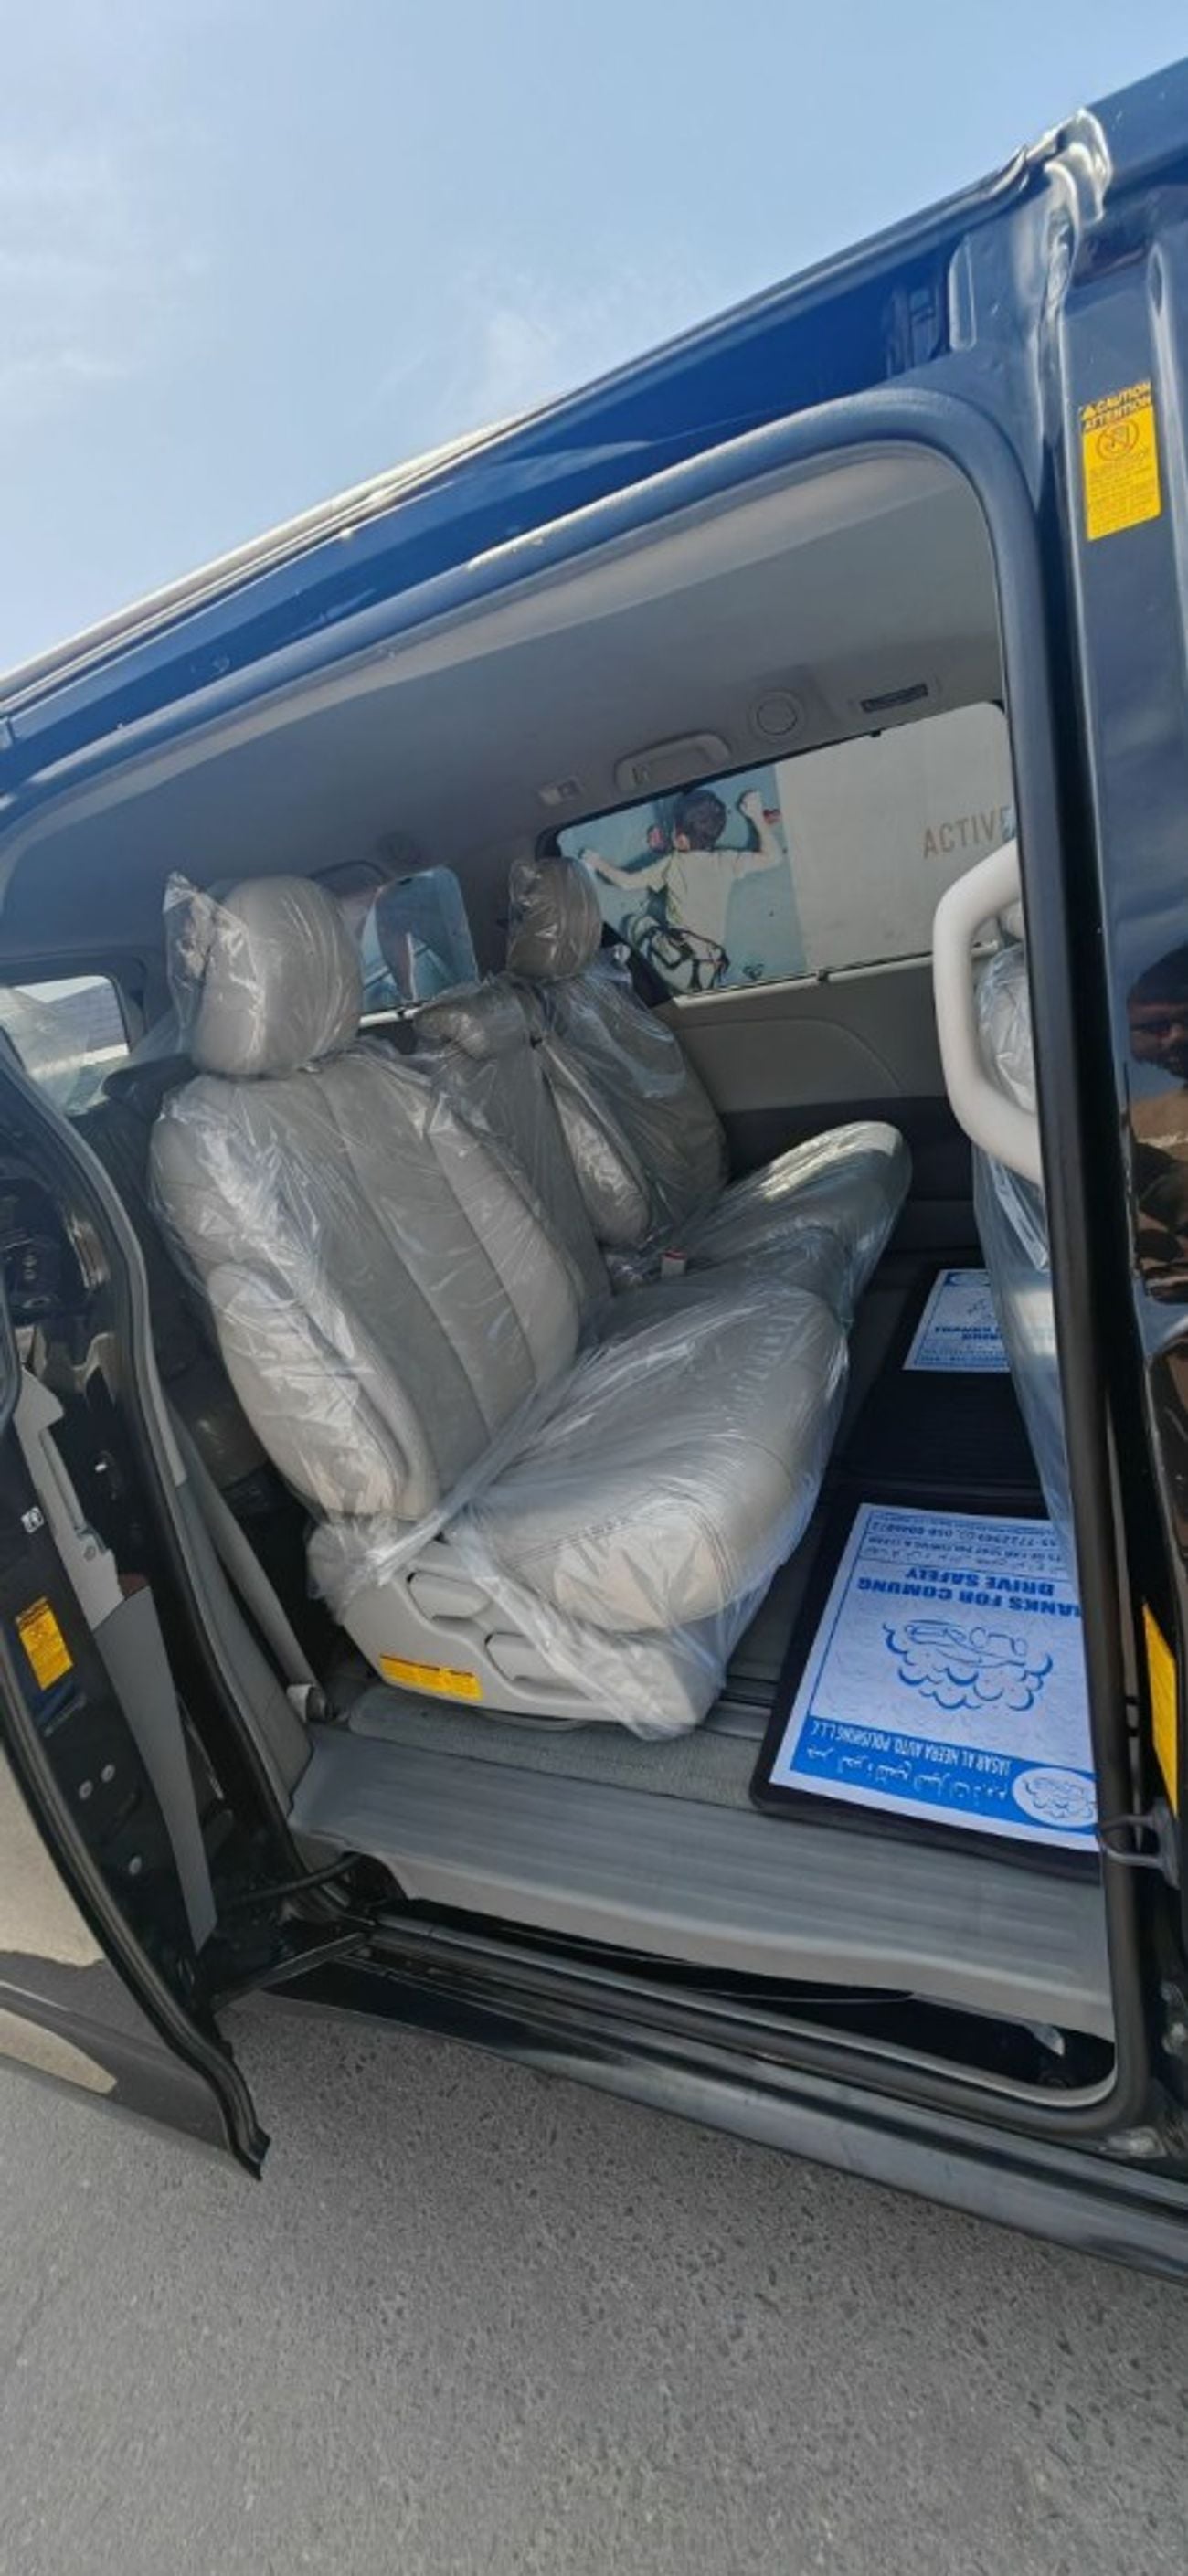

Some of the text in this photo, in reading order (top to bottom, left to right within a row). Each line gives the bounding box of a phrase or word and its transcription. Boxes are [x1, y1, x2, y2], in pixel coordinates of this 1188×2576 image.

[1094, 380, 1151, 414] CAUTION
[905, 1567, 1055, 1596] DRIVE SAFELY
[959, 1590, 1003, 1607] FOR
[1008, 1596, 1082, 1617] HANKS
[961, 1754, 976, 1770] AL
